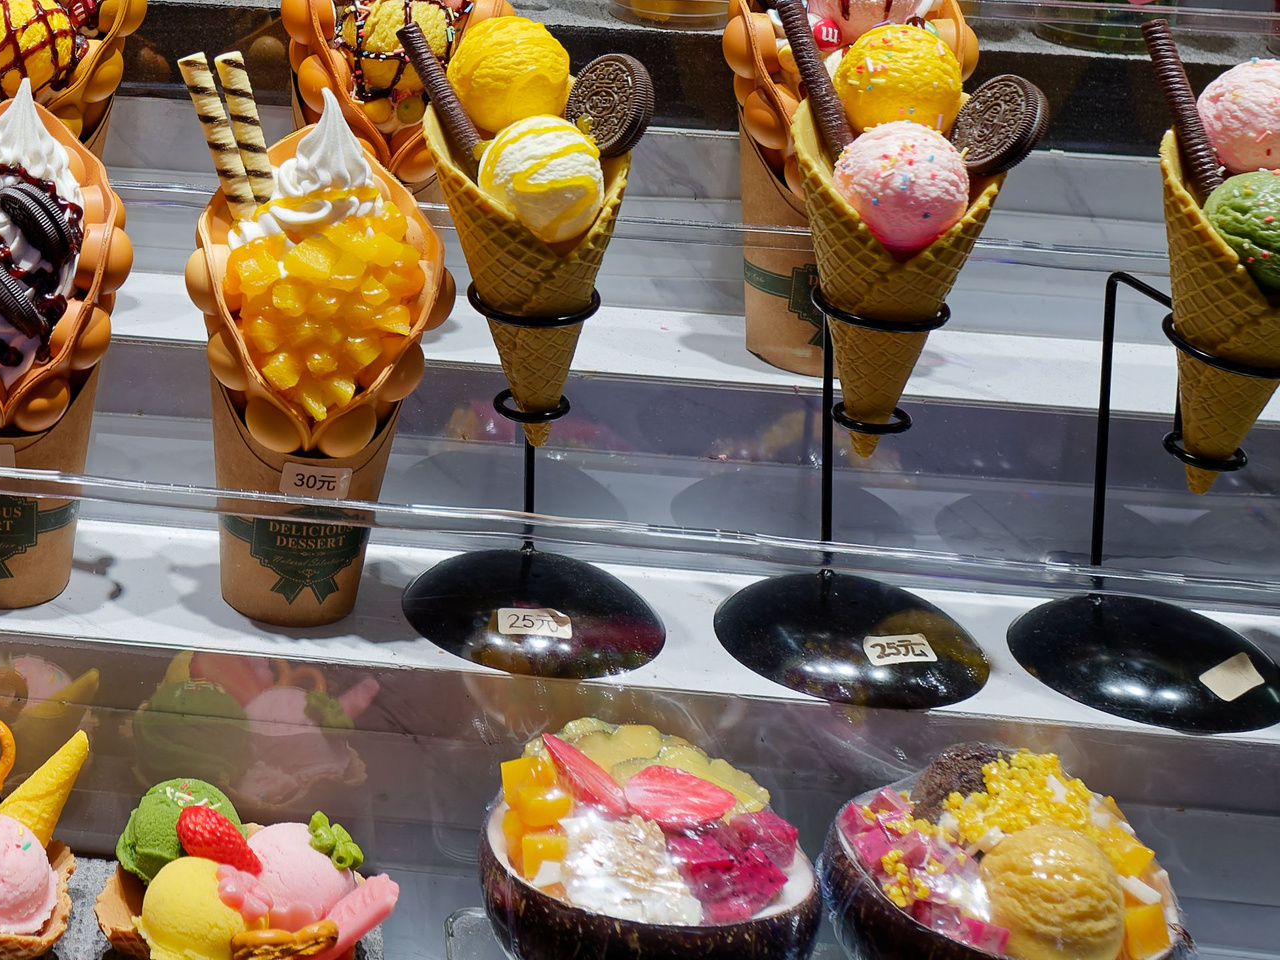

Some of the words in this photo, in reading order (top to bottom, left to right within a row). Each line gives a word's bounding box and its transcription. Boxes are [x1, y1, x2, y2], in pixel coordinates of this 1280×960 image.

[293, 473, 337, 491] 30元
[276, 535, 346, 549] DESSERT
[507, 614, 559, 632] 25元
[870, 640, 929, 659] 25元
